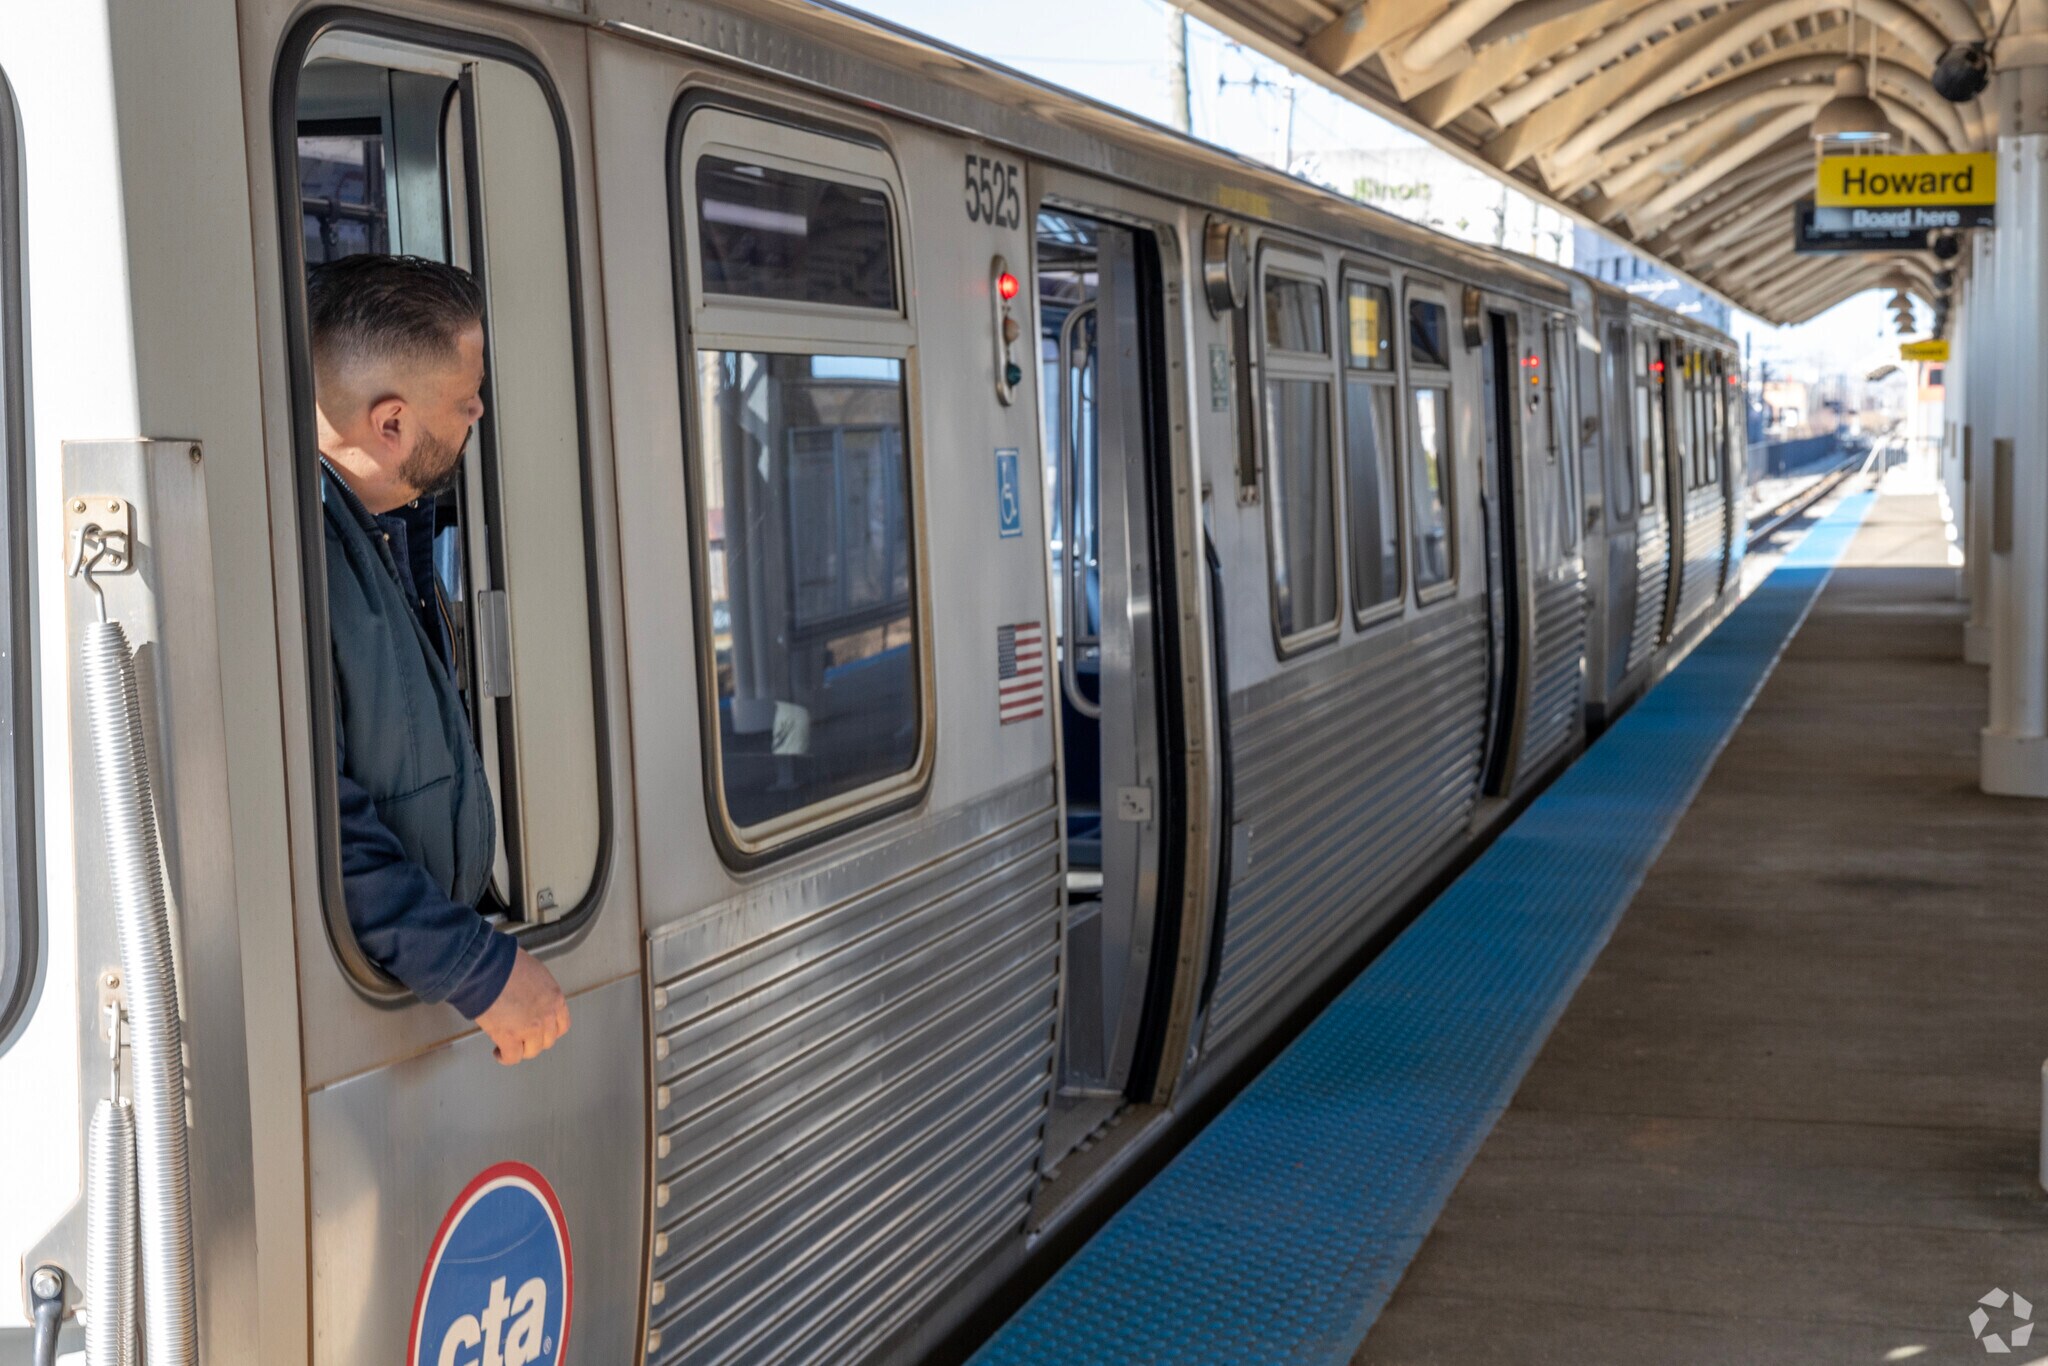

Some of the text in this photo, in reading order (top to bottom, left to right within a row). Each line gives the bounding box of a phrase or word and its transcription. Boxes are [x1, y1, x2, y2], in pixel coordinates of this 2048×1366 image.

[966, 154, 1020, 230] 5525
[1842, 165, 1974, 196] Howard
[1853, 208, 1912, 228] Board
[1915, 207, 1961, 228] here
[437, 1275, 547, 1366] cta
